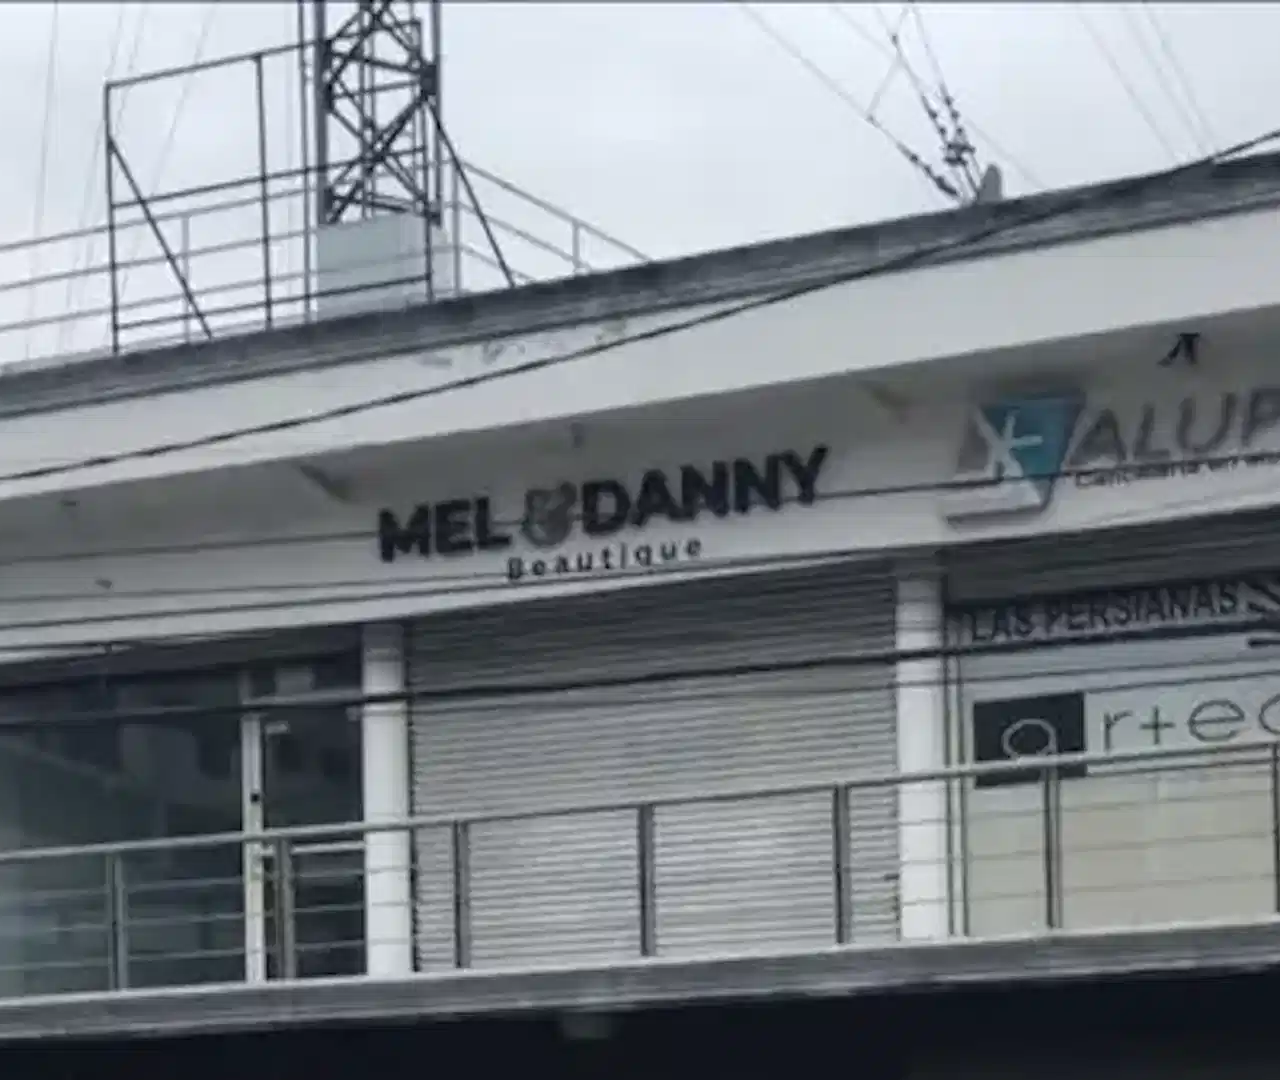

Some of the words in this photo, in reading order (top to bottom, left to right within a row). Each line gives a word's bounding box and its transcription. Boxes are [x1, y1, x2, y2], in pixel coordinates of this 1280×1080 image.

[377, 495, 511, 564] MEL
[581, 444, 829, 536] DANNY
[506, 537, 704, 581] Beautique
